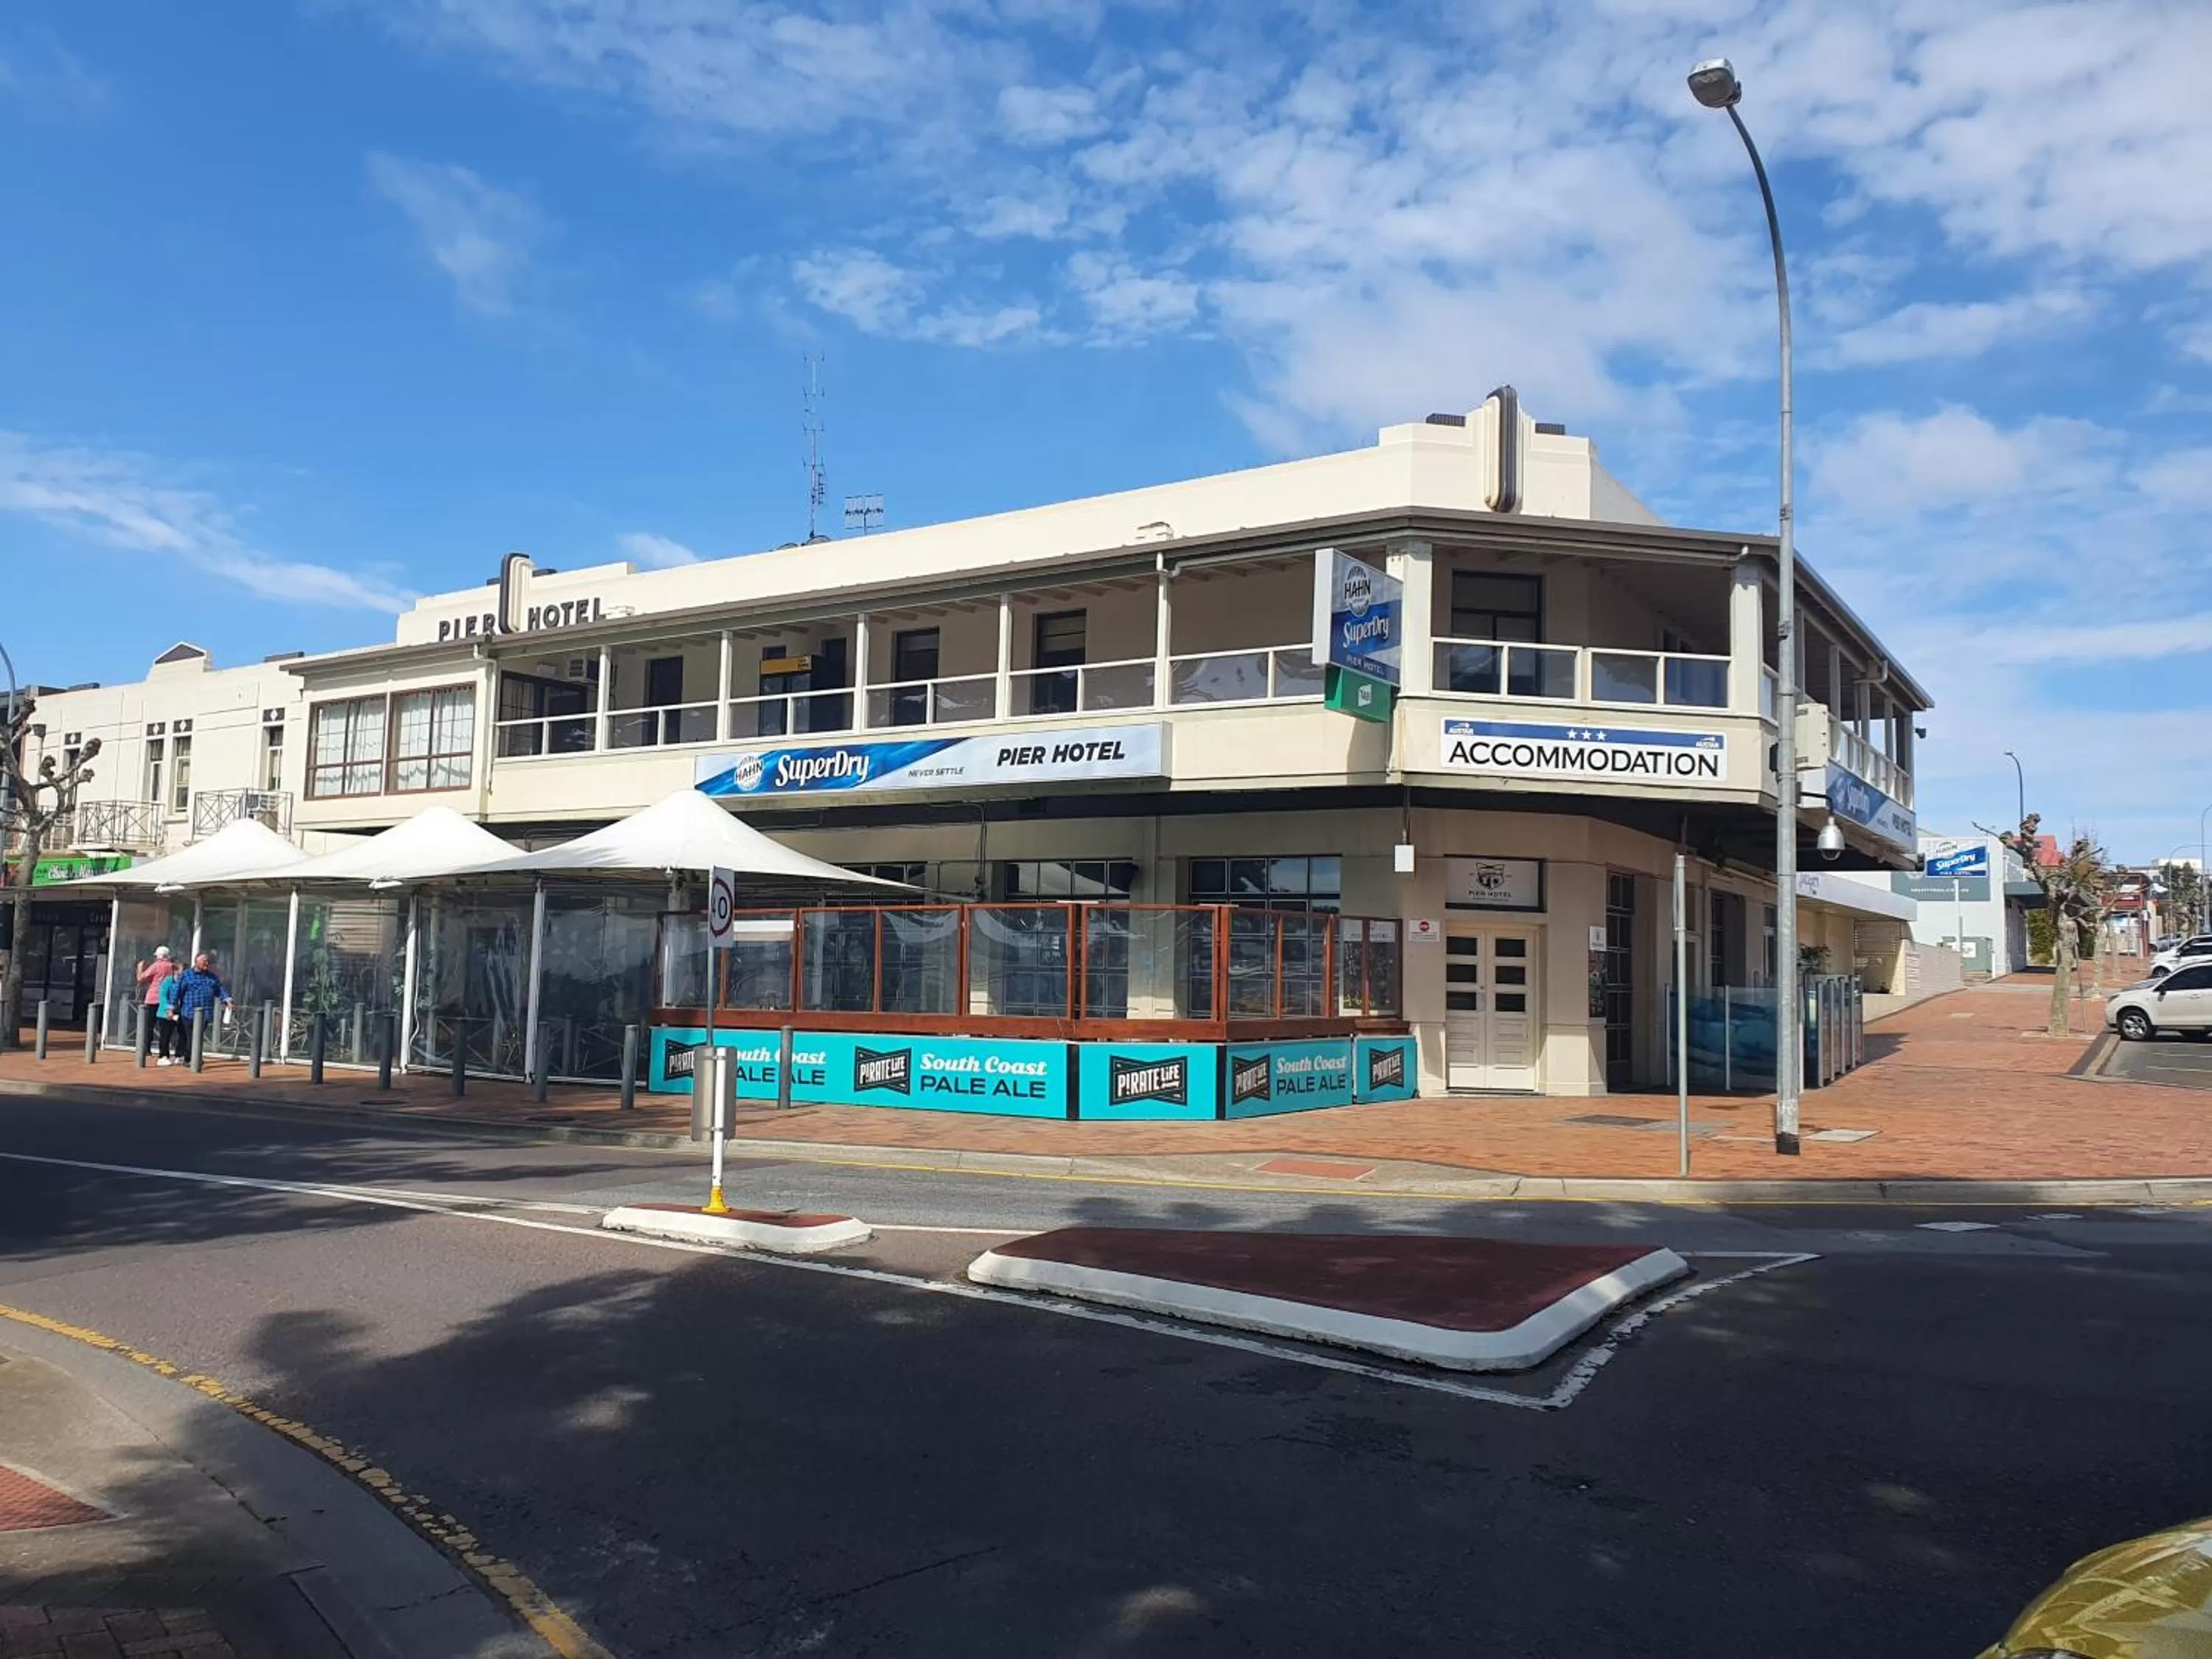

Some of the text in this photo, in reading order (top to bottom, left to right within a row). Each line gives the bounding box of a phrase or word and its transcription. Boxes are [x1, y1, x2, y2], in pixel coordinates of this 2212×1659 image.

[1344, 578, 1371, 600] HAHN
[439, 597, 606, 641] PIER HOTEL
[1343, 616, 1389, 648] SuperDry
[997, 741, 1125, 767] PIER HOTEL
[1448, 740, 1719, 776] ACCOMMODATION
[736, 760, 763, 782] HAHN
[776, 751, 869, 787] SuperDry
[908, 767, 965, 778] NEVER SETTLE
[737, 1066, 776, 1082] ALE
[920, 1053, 1047, 1075] South Coast
[1276, 1054, 1346, 1074] South Coast
[920, 1075, 1046, 1099] PALE ALE
[1276, 1074, 1346, 1096] PALE ALE
